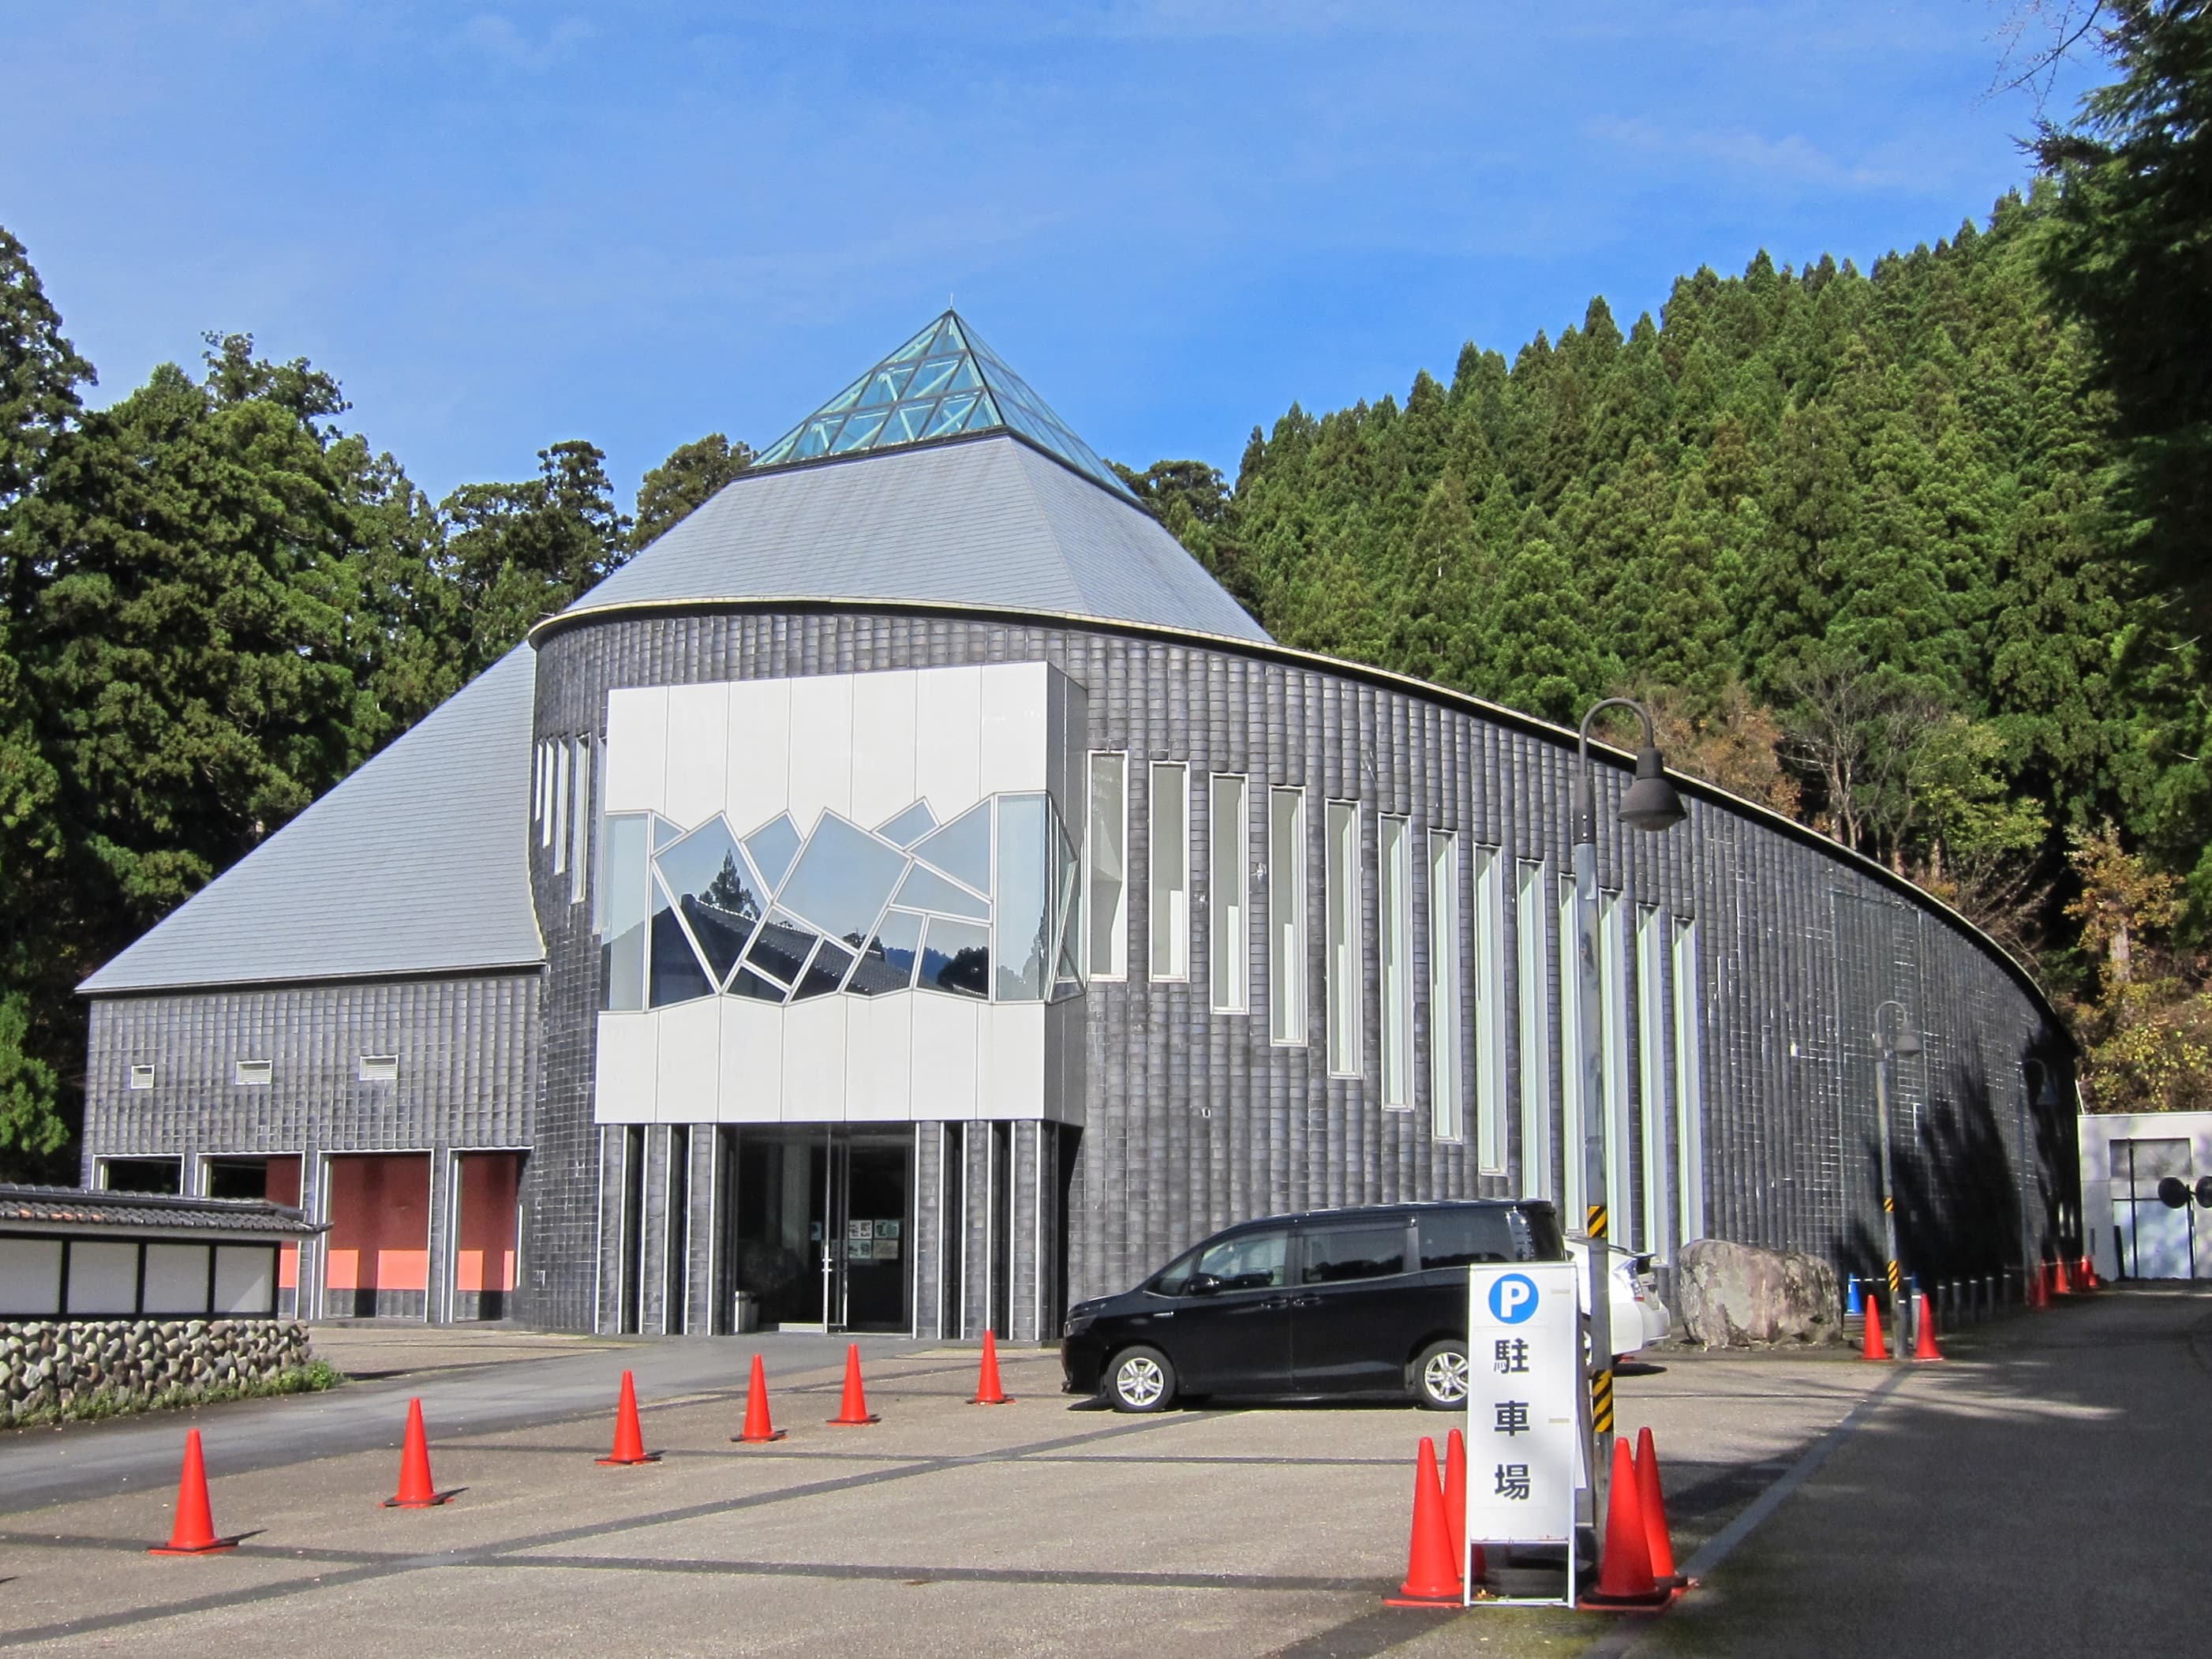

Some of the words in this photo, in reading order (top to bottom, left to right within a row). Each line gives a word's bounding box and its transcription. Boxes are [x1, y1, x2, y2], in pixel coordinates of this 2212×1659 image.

[1500, 1280, 1530, 1318] P
[1494, 1338, 1530, 1500] 駐車場
